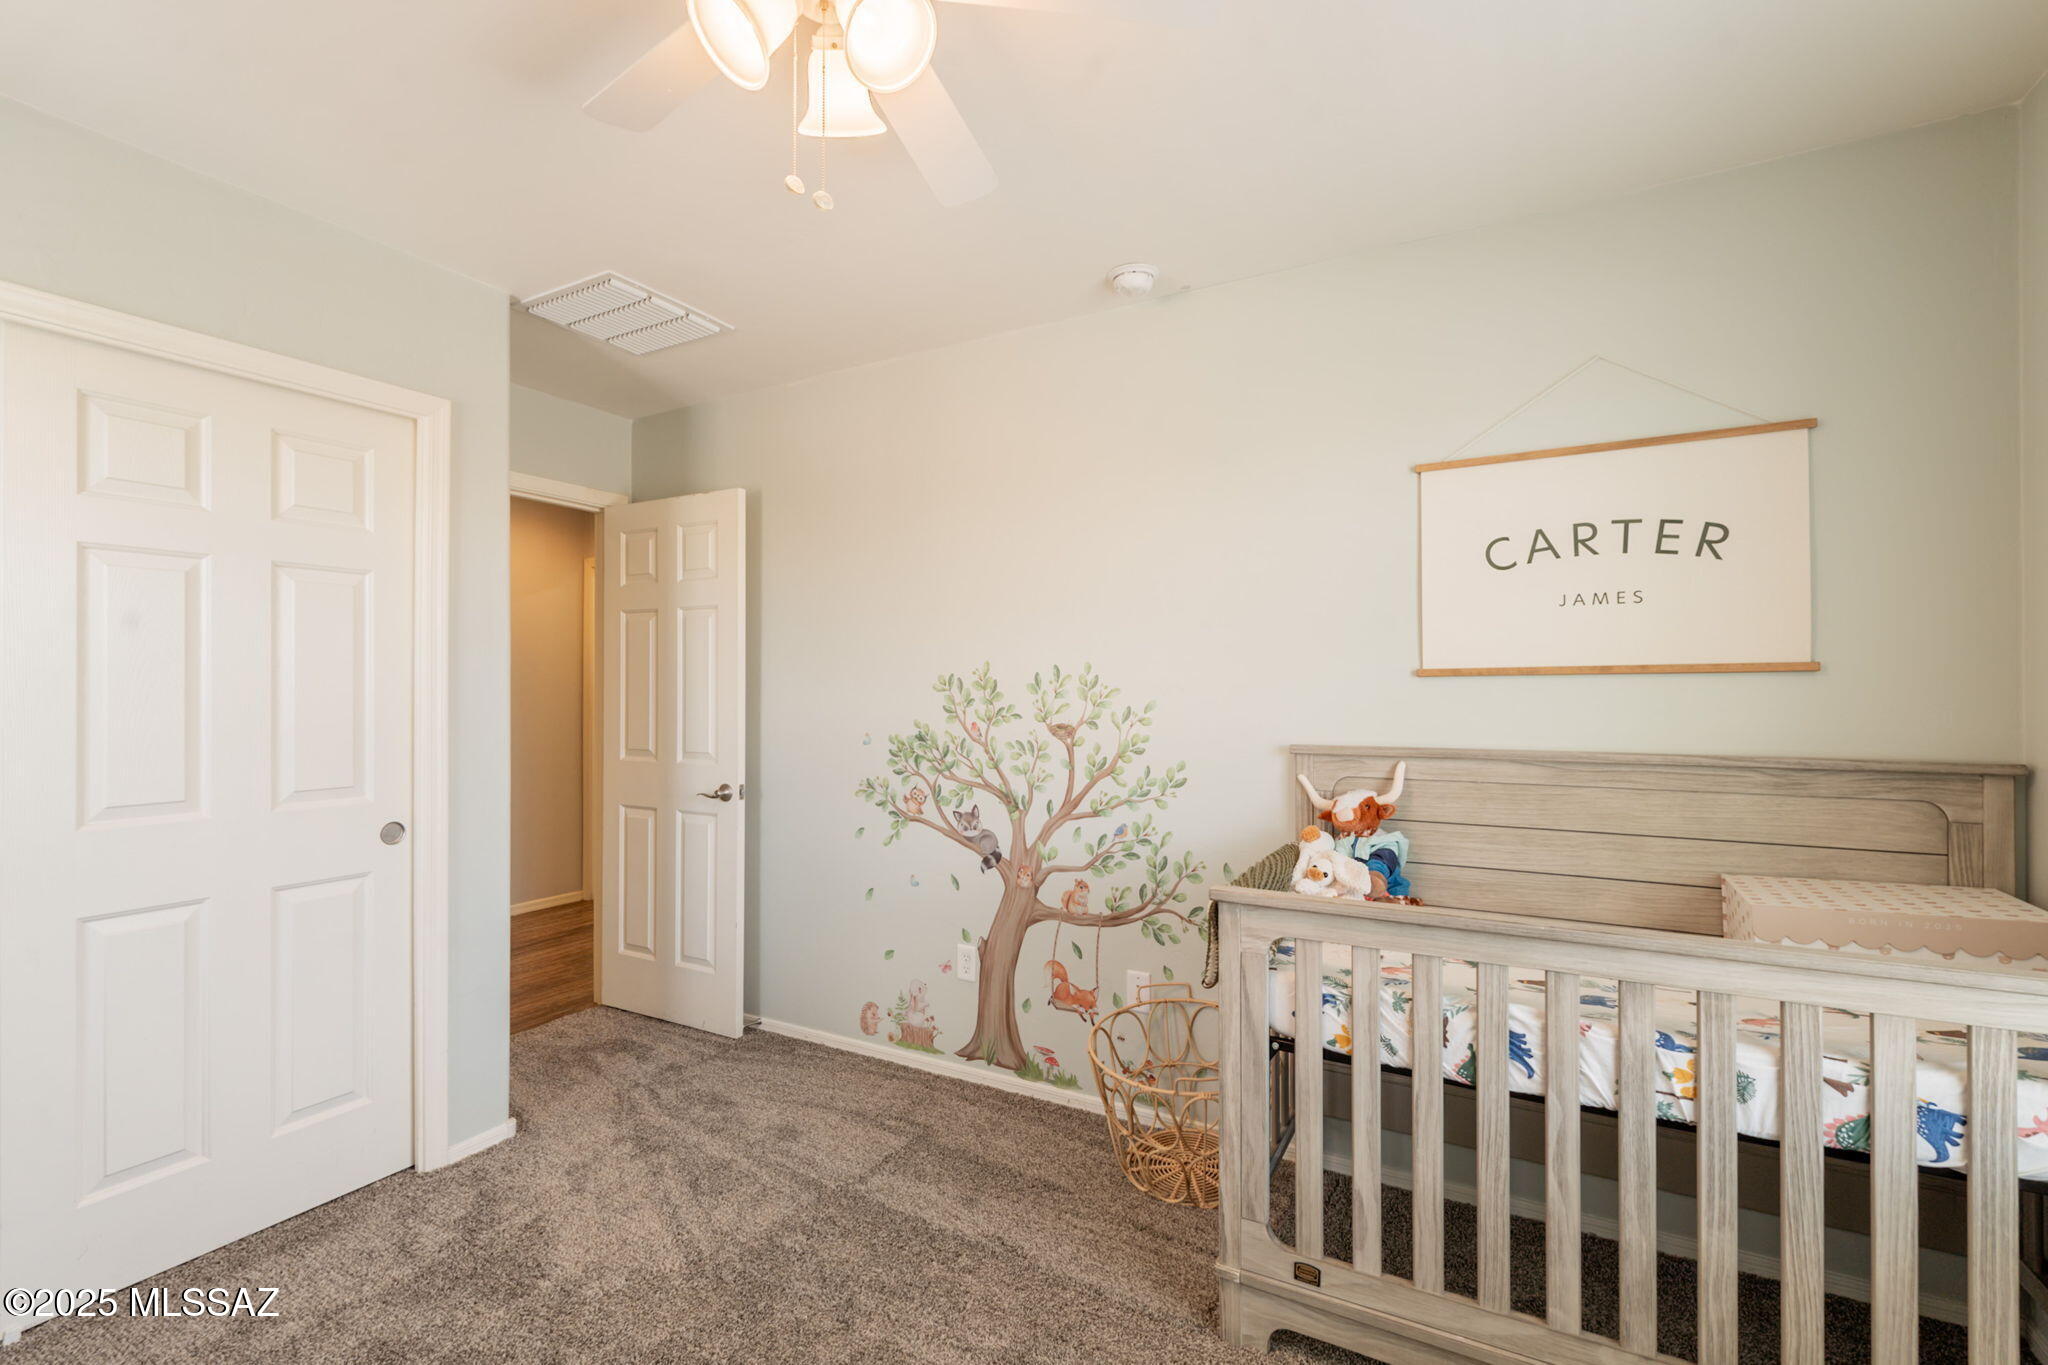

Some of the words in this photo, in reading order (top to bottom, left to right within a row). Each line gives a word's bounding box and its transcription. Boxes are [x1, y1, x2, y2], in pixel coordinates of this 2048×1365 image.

[1485, 518, 1730, 571] CARTER
[1559, 589, 1645, 607] JAMES
[1848, 917, 1888, 927] BORN
[1898, 920, 1913, 928] IN
